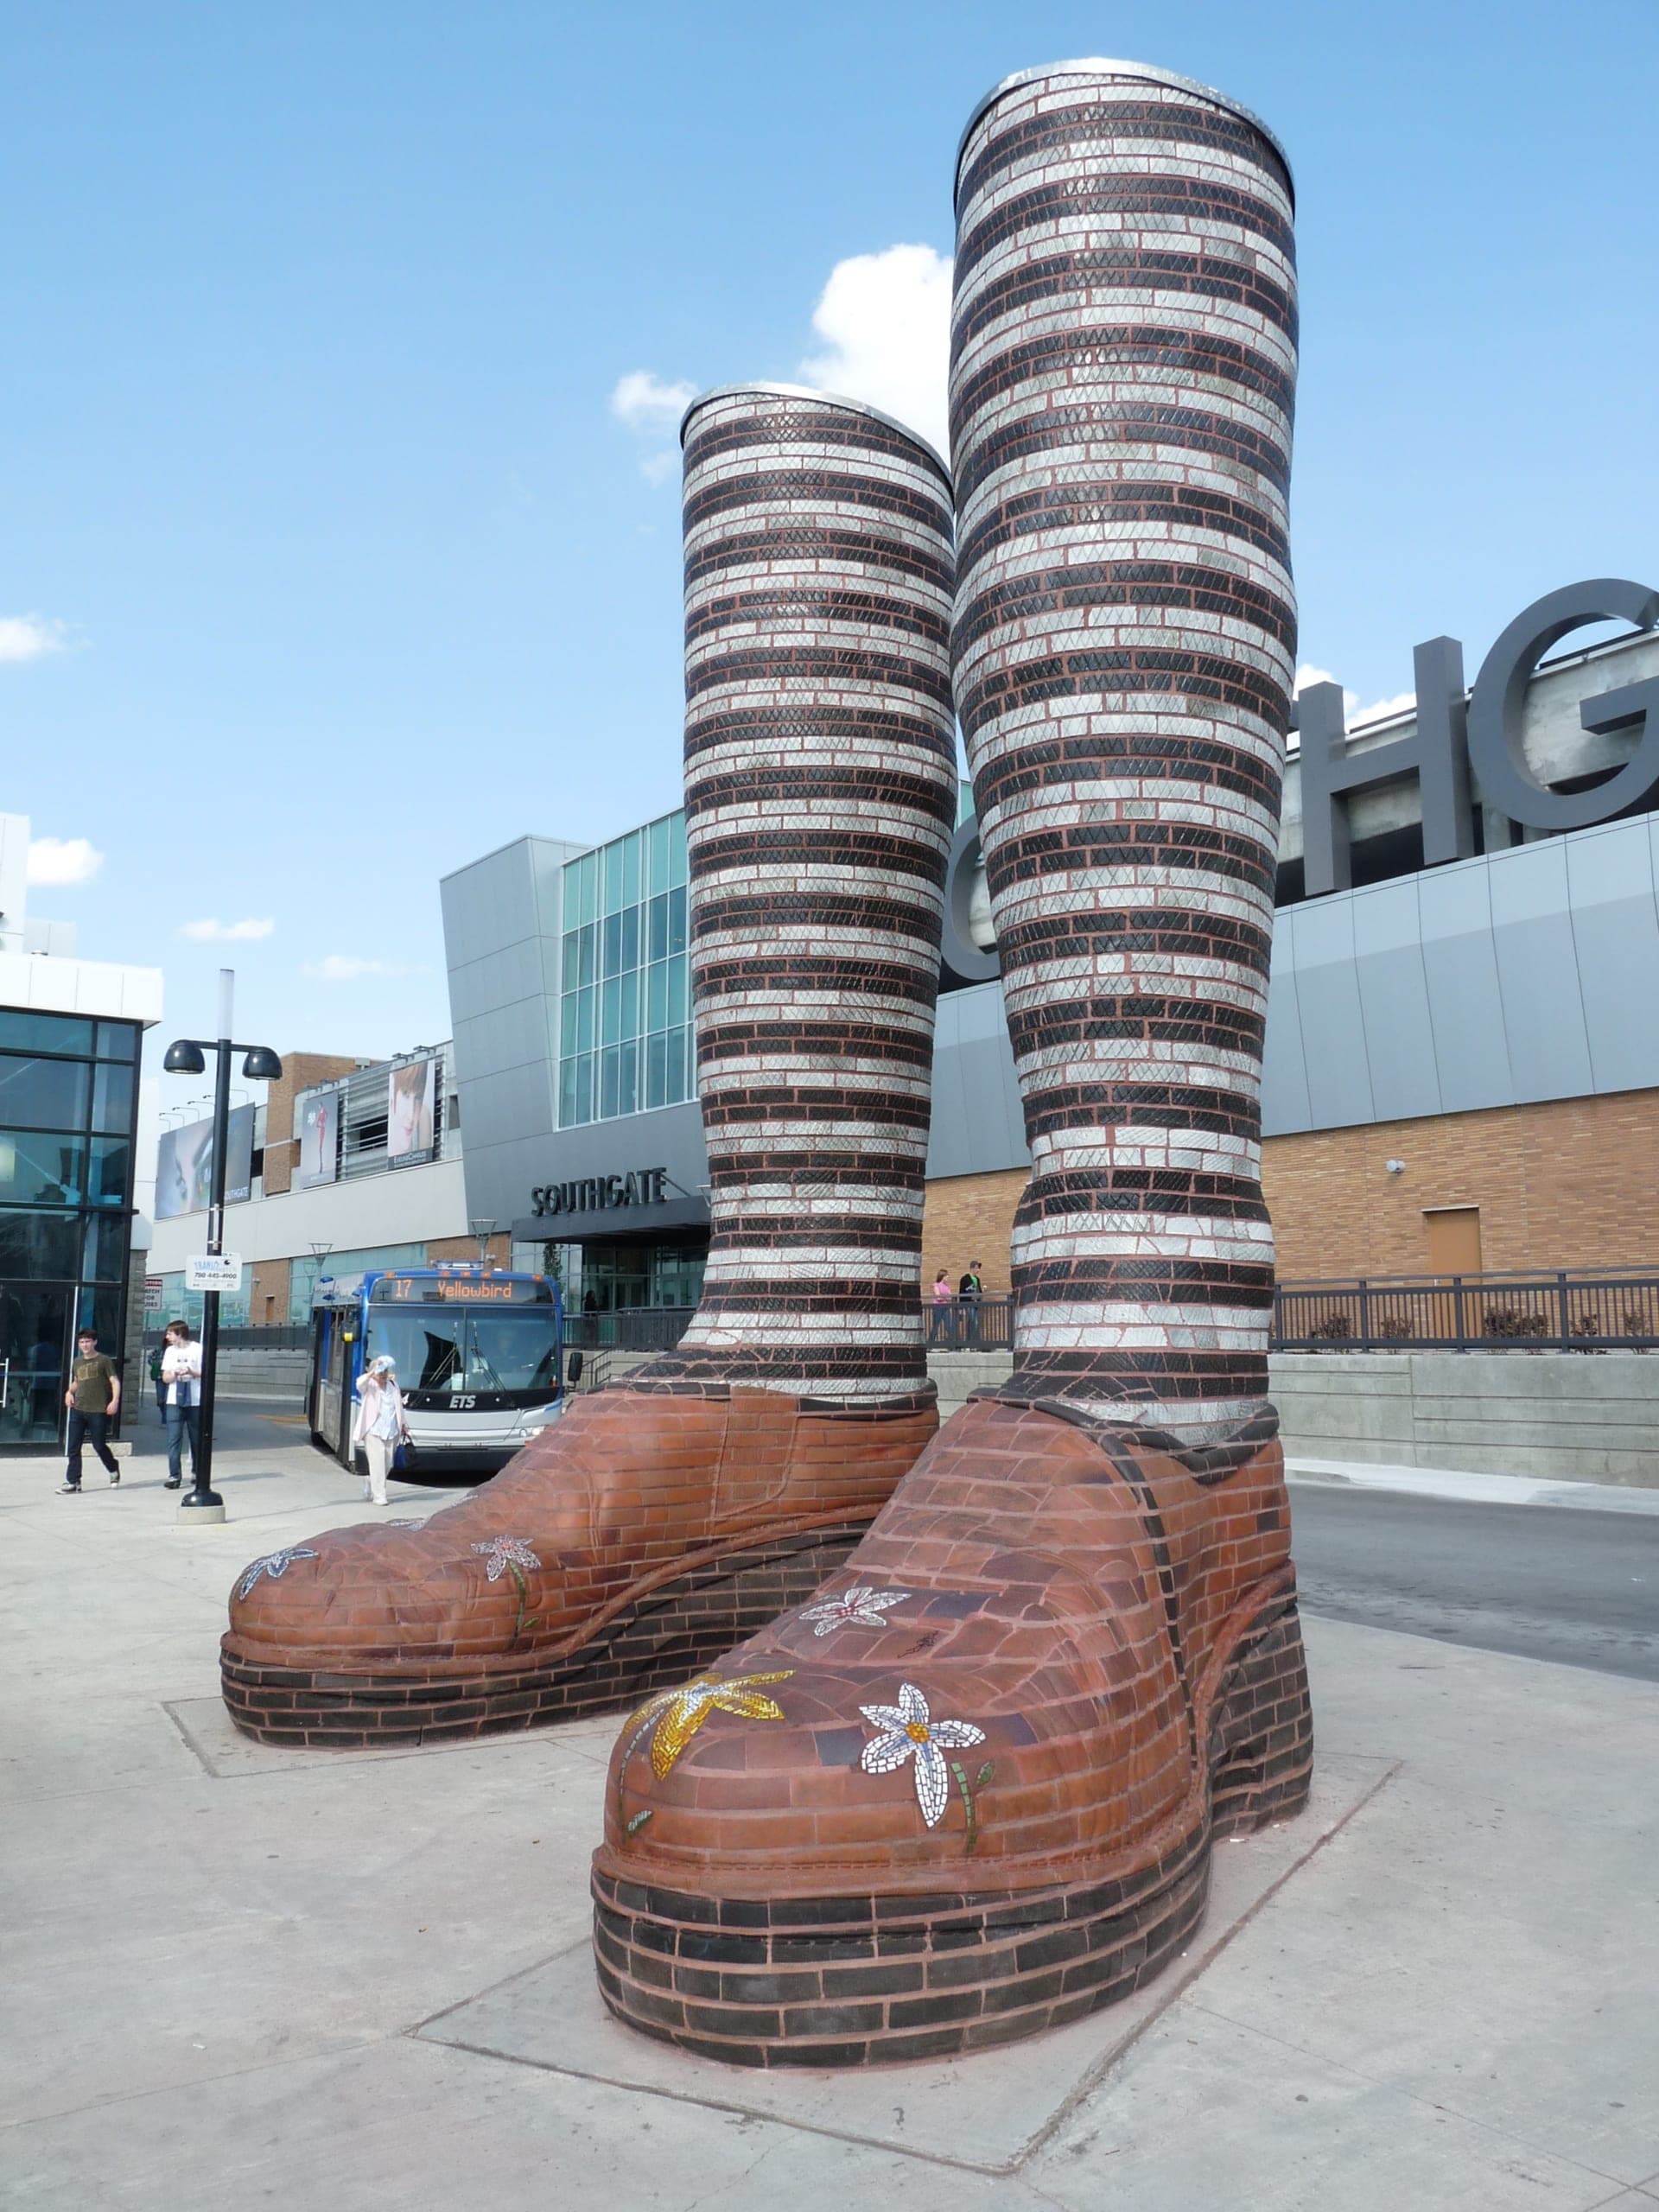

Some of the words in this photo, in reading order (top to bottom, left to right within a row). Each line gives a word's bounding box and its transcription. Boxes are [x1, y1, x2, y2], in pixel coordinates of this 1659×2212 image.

[531, 1166, 667, 1217] SOUTHGATE
[395, 1279, 412, 1298] 17
[437, 1280, 512, 1299] Yellowbird
[449, 1395, 476, 1409] ETS
